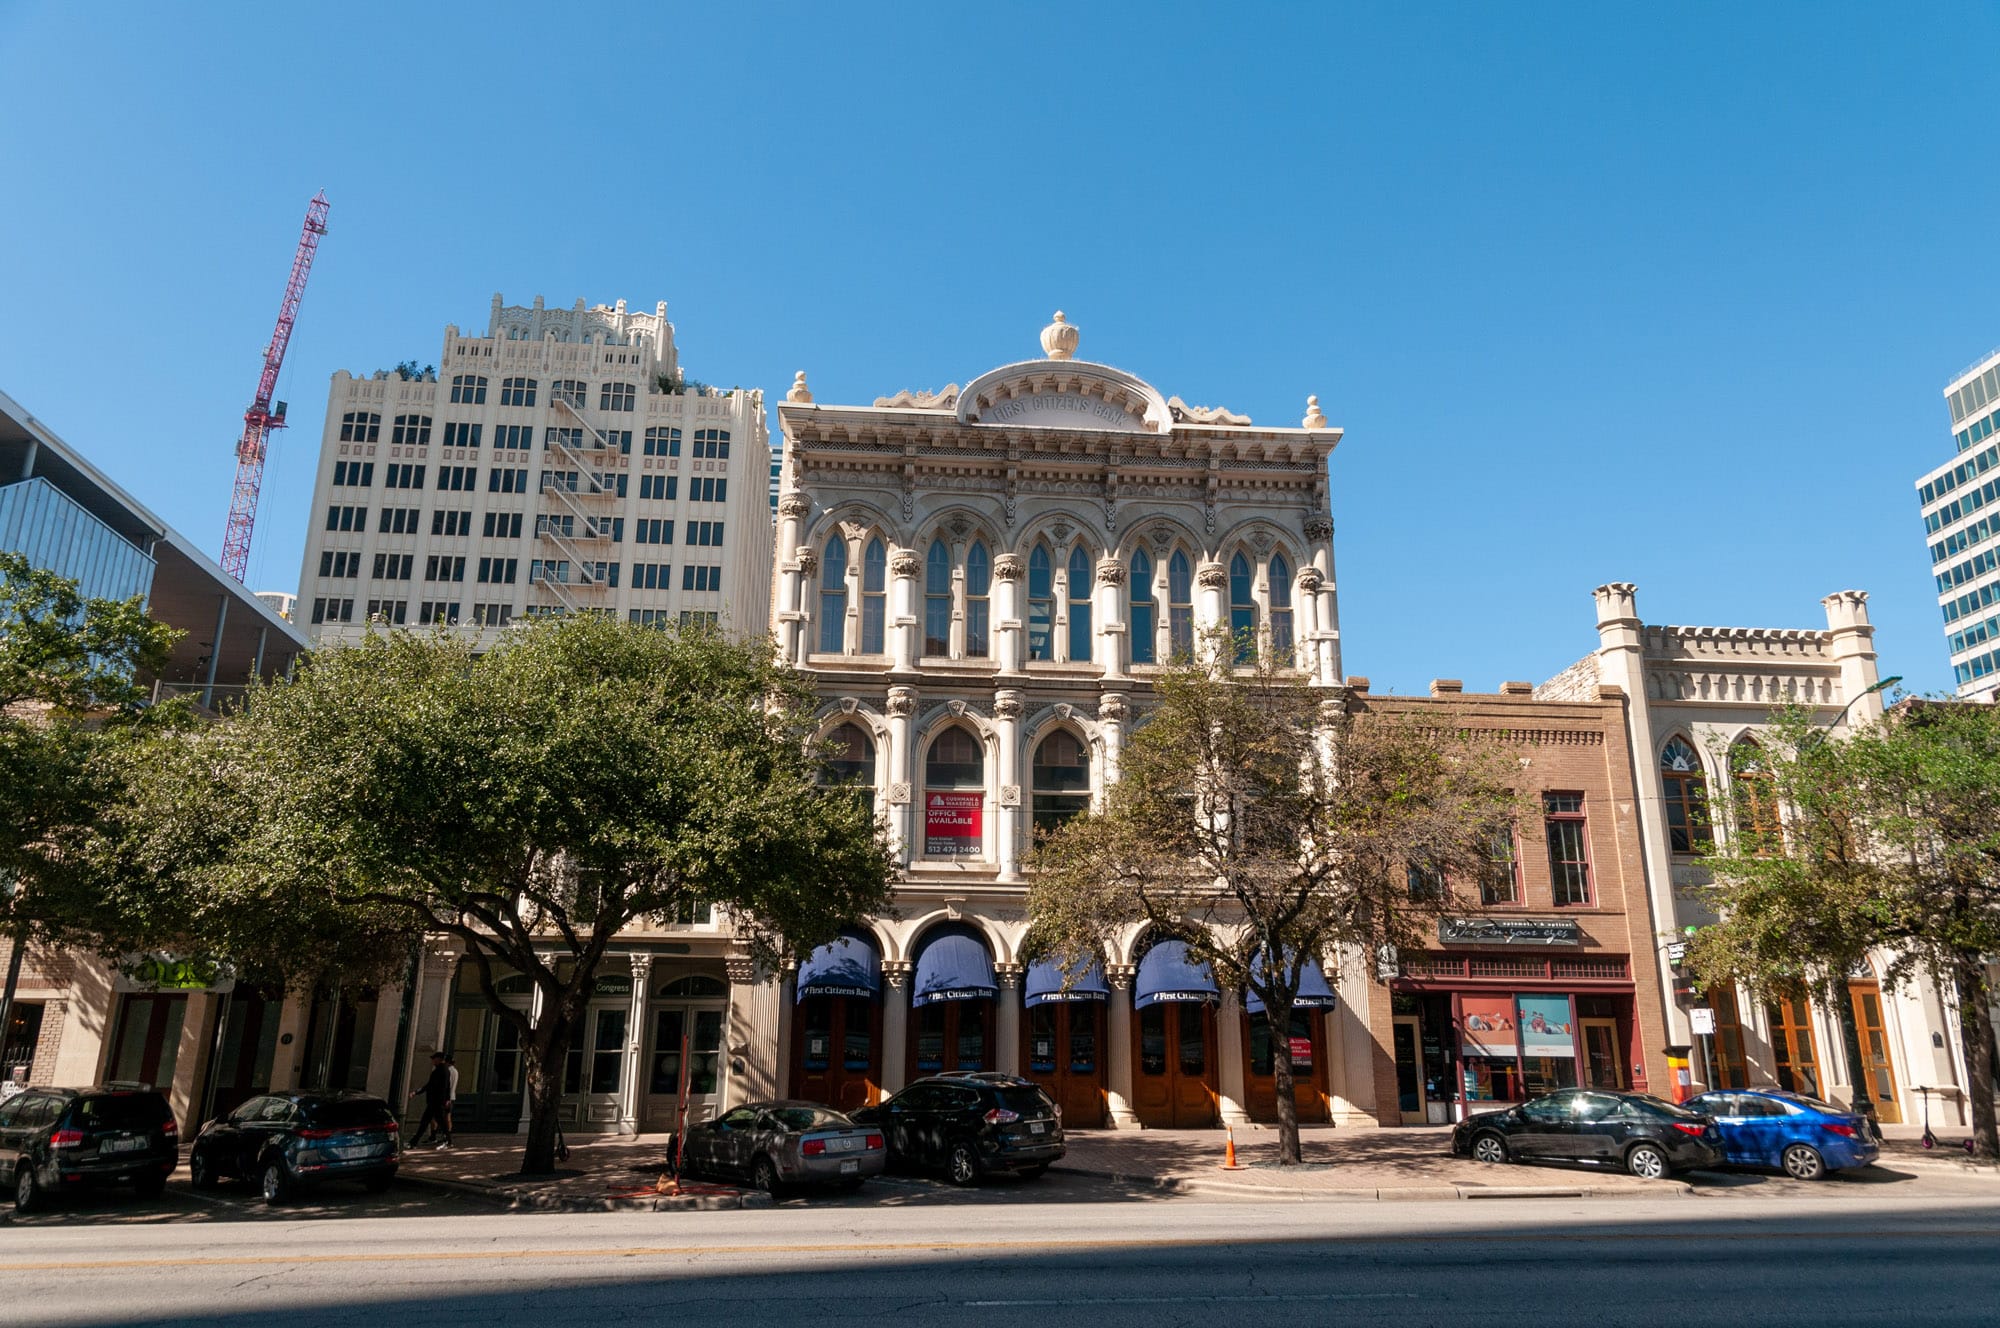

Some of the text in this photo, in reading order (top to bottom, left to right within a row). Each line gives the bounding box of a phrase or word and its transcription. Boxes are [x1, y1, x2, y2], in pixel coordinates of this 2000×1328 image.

[993, 394, 1128, 426] FIRST CITIZENS BANK
[928, 817, 973, 825] AVAILABLE
[1506, 928, 1538, 943] your
[1543, 929, 1569, 944] eyes
[596, 983, 630, 994] Congress
[809, 986, 871, 997] First Citizens Bank
[932, 989, 993, 1000] First Citizens Bank
[1159, 992, 1176, 1001] First
[1293, 997, 1322, 1006] Citizens
